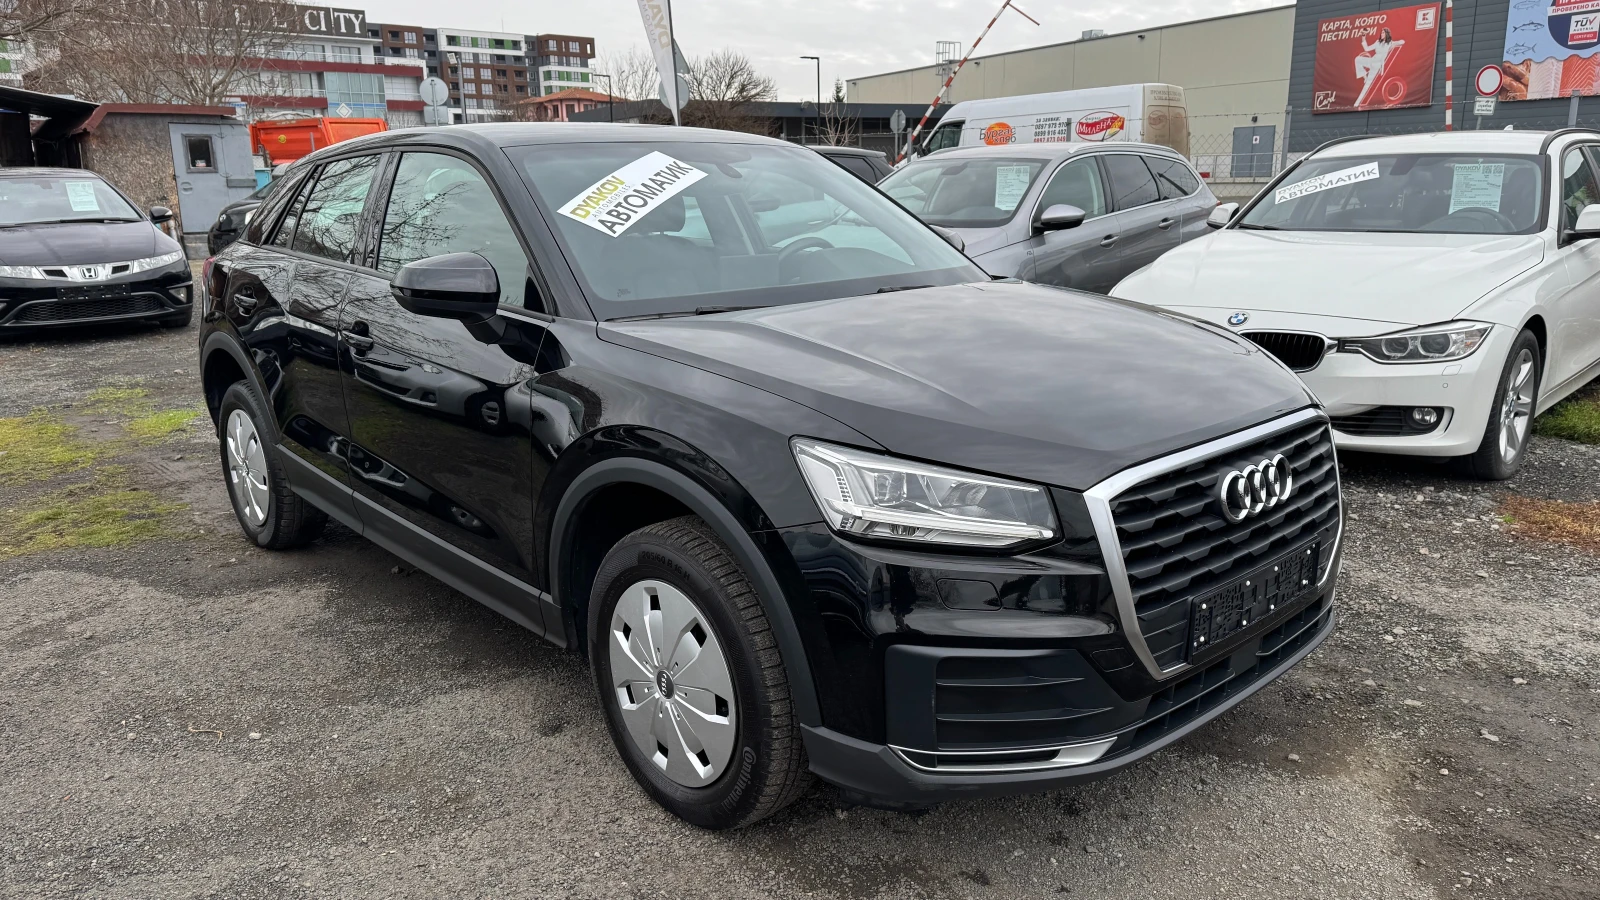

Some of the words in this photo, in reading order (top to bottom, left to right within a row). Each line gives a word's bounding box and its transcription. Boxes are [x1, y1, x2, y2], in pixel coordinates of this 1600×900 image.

[1552, 4, 1589, 14] ПРОВЕРЕНО
[303, 10, 364, 34] CITY
[1321, 19, 1352, 32] КАРТА,
[1354, 14, 1387, 28] КОЯТО
[1320, 31, 1349, 42] ПЕСТИ
[979, 127, 1016, 141] Бургас
[1277, 167, 1377, 204] АВТОМАТИК
[1278, 175, 1325, 195] DYAKOV
[569, 175, 625, 220] DYAKOV
[592, 184, 632, 218] AUTOMOBILES
[598, 161, 694, 235] АВТОМАТИК
[720, 746, 757, 815] Continental
